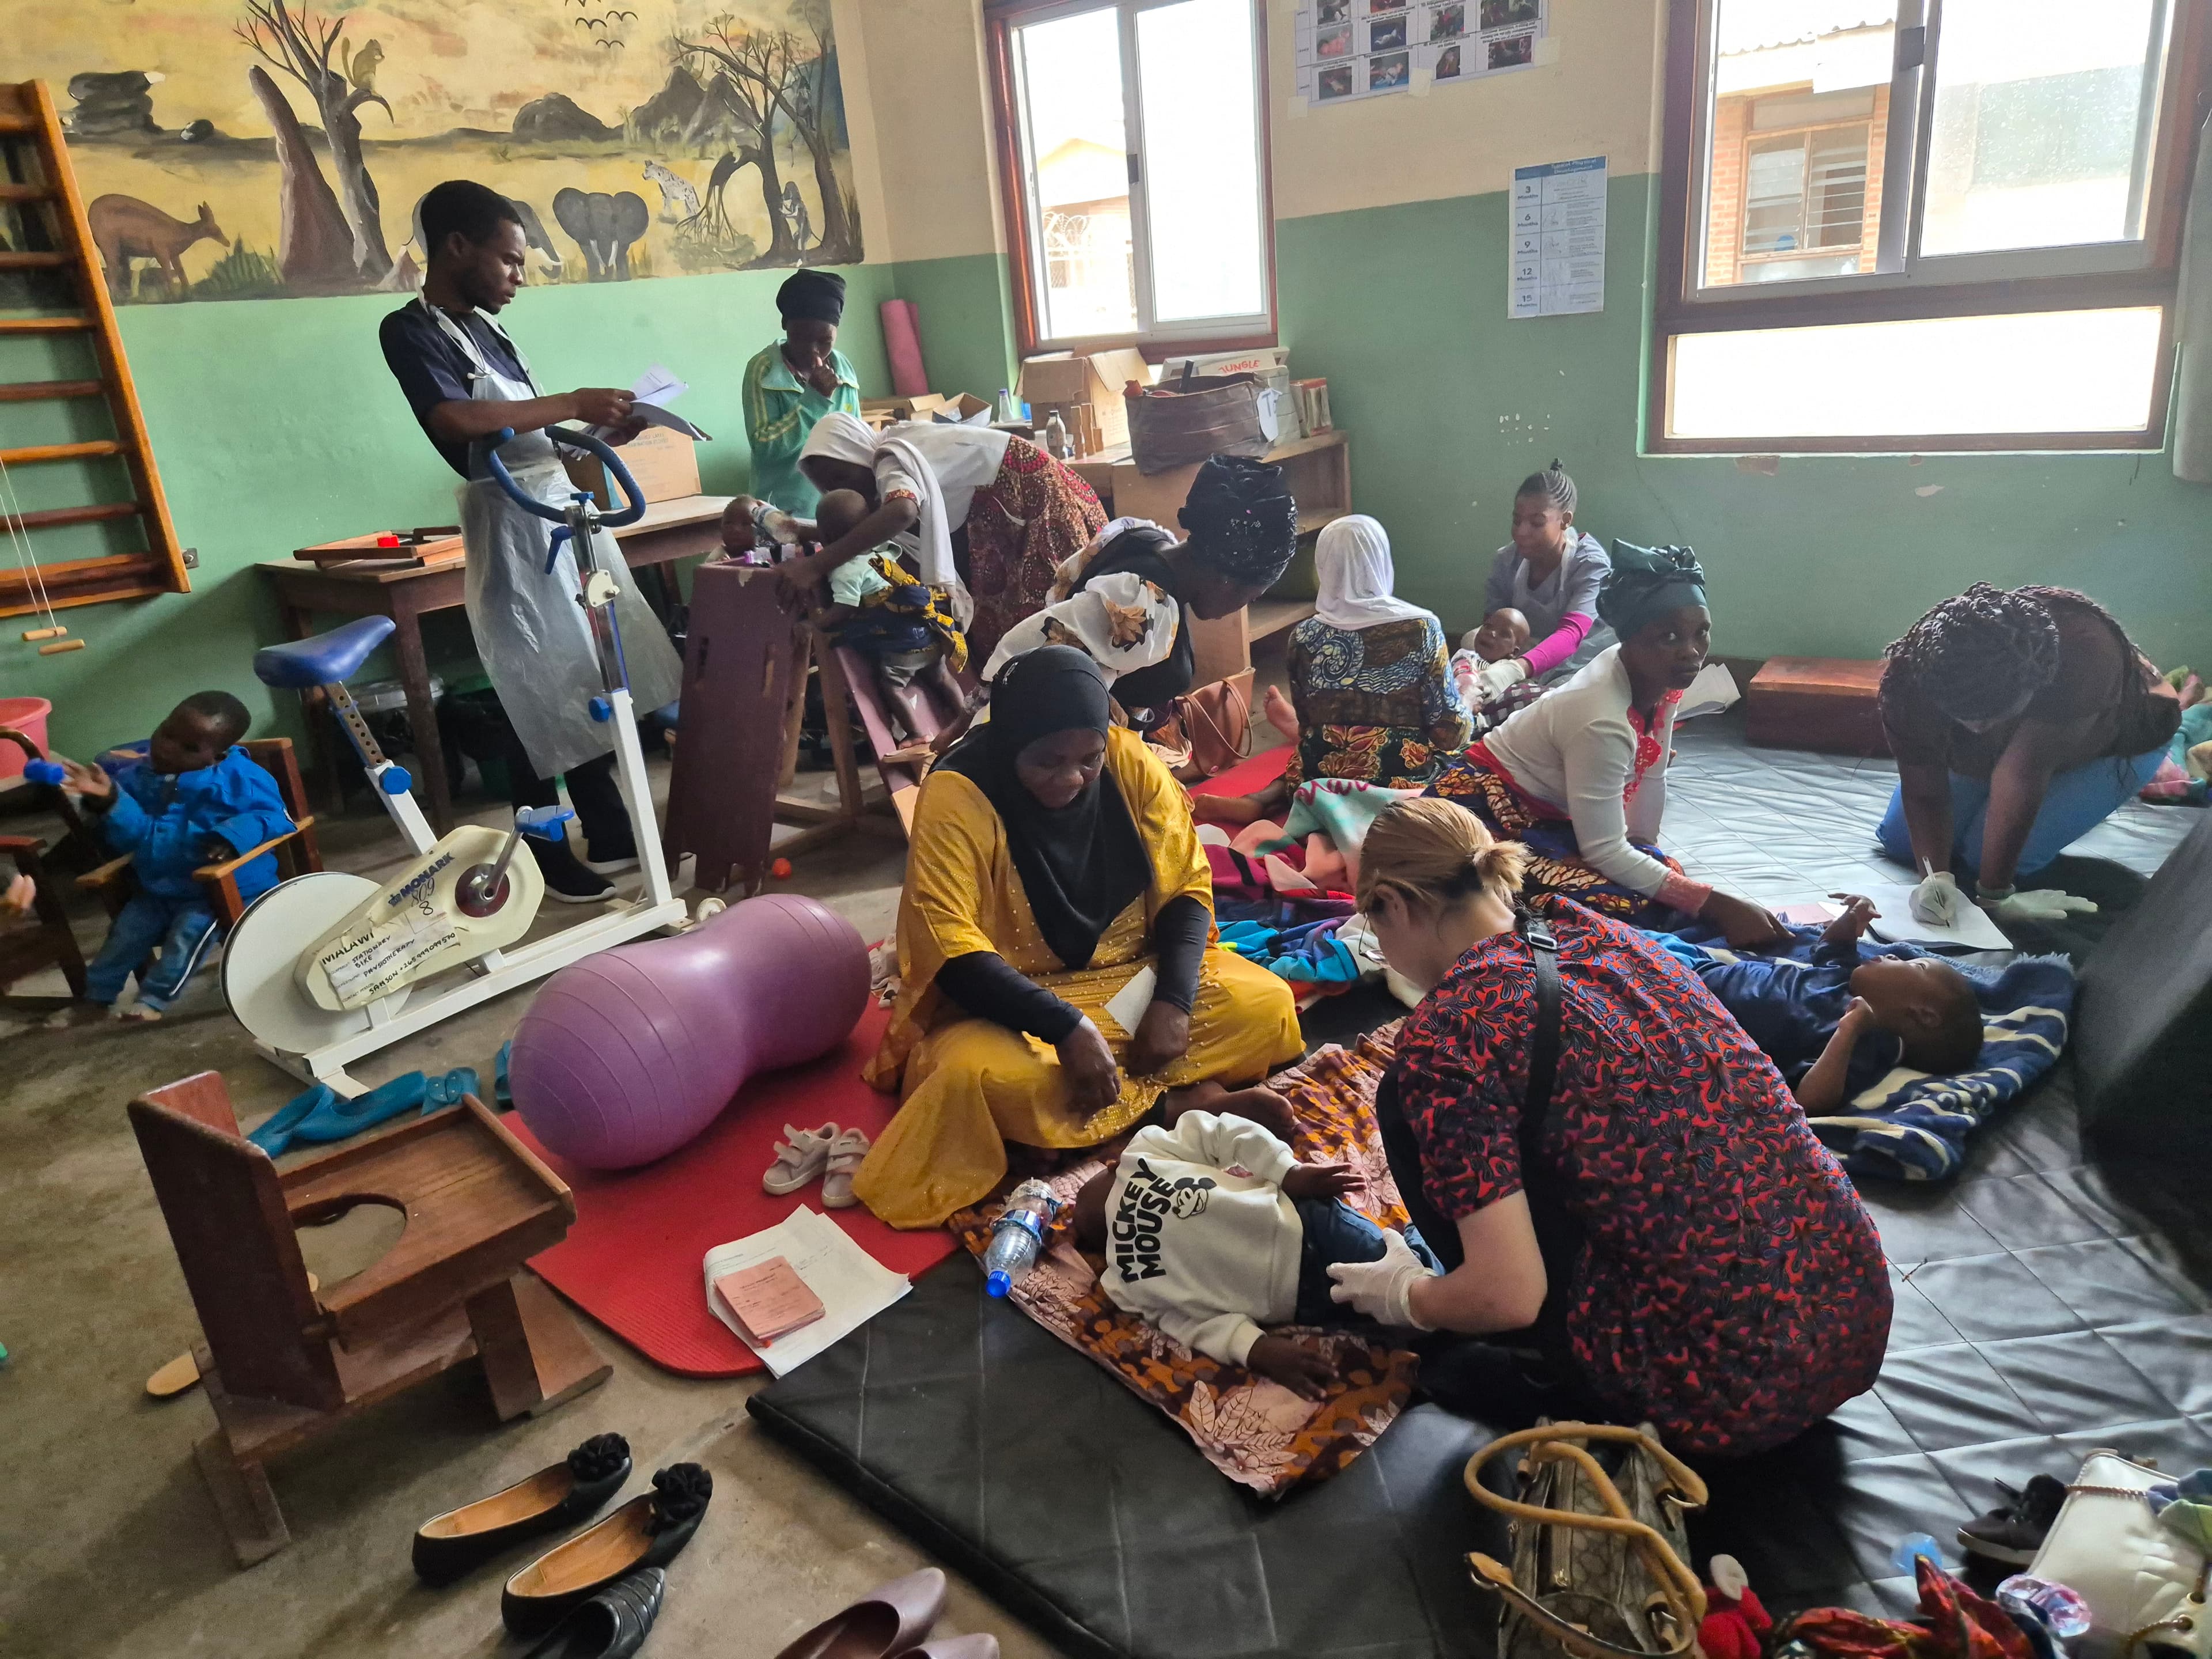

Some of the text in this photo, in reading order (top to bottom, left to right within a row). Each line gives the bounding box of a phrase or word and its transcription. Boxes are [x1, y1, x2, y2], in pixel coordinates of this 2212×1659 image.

[1525, 185, 1532, 194] 3
[1524, 213, 1531, 221] 6
[1524, 241, 1531, 249] 9
[1522, 267, 1533, 276] 12
[1521, 294, 1532, 303] 15
[1219, 359, 1260, 373] JUNGLE
[399, 851, 456, 897] MONARK
[419, 900, 434, 915] 8
[322, 931, 374, 965] MALAWI
[352, 935, 391, 964] STATIONARY
[355, 954, 373, 968] BIKE
[363, 938, 415, 978] PHYSIOTHERAPY
[369, 970, 399, 995] SAMSON
[1112, 1157, 1158, 1283] MICKEY
[1134, 1176, 1176, 1279] MOUSE
